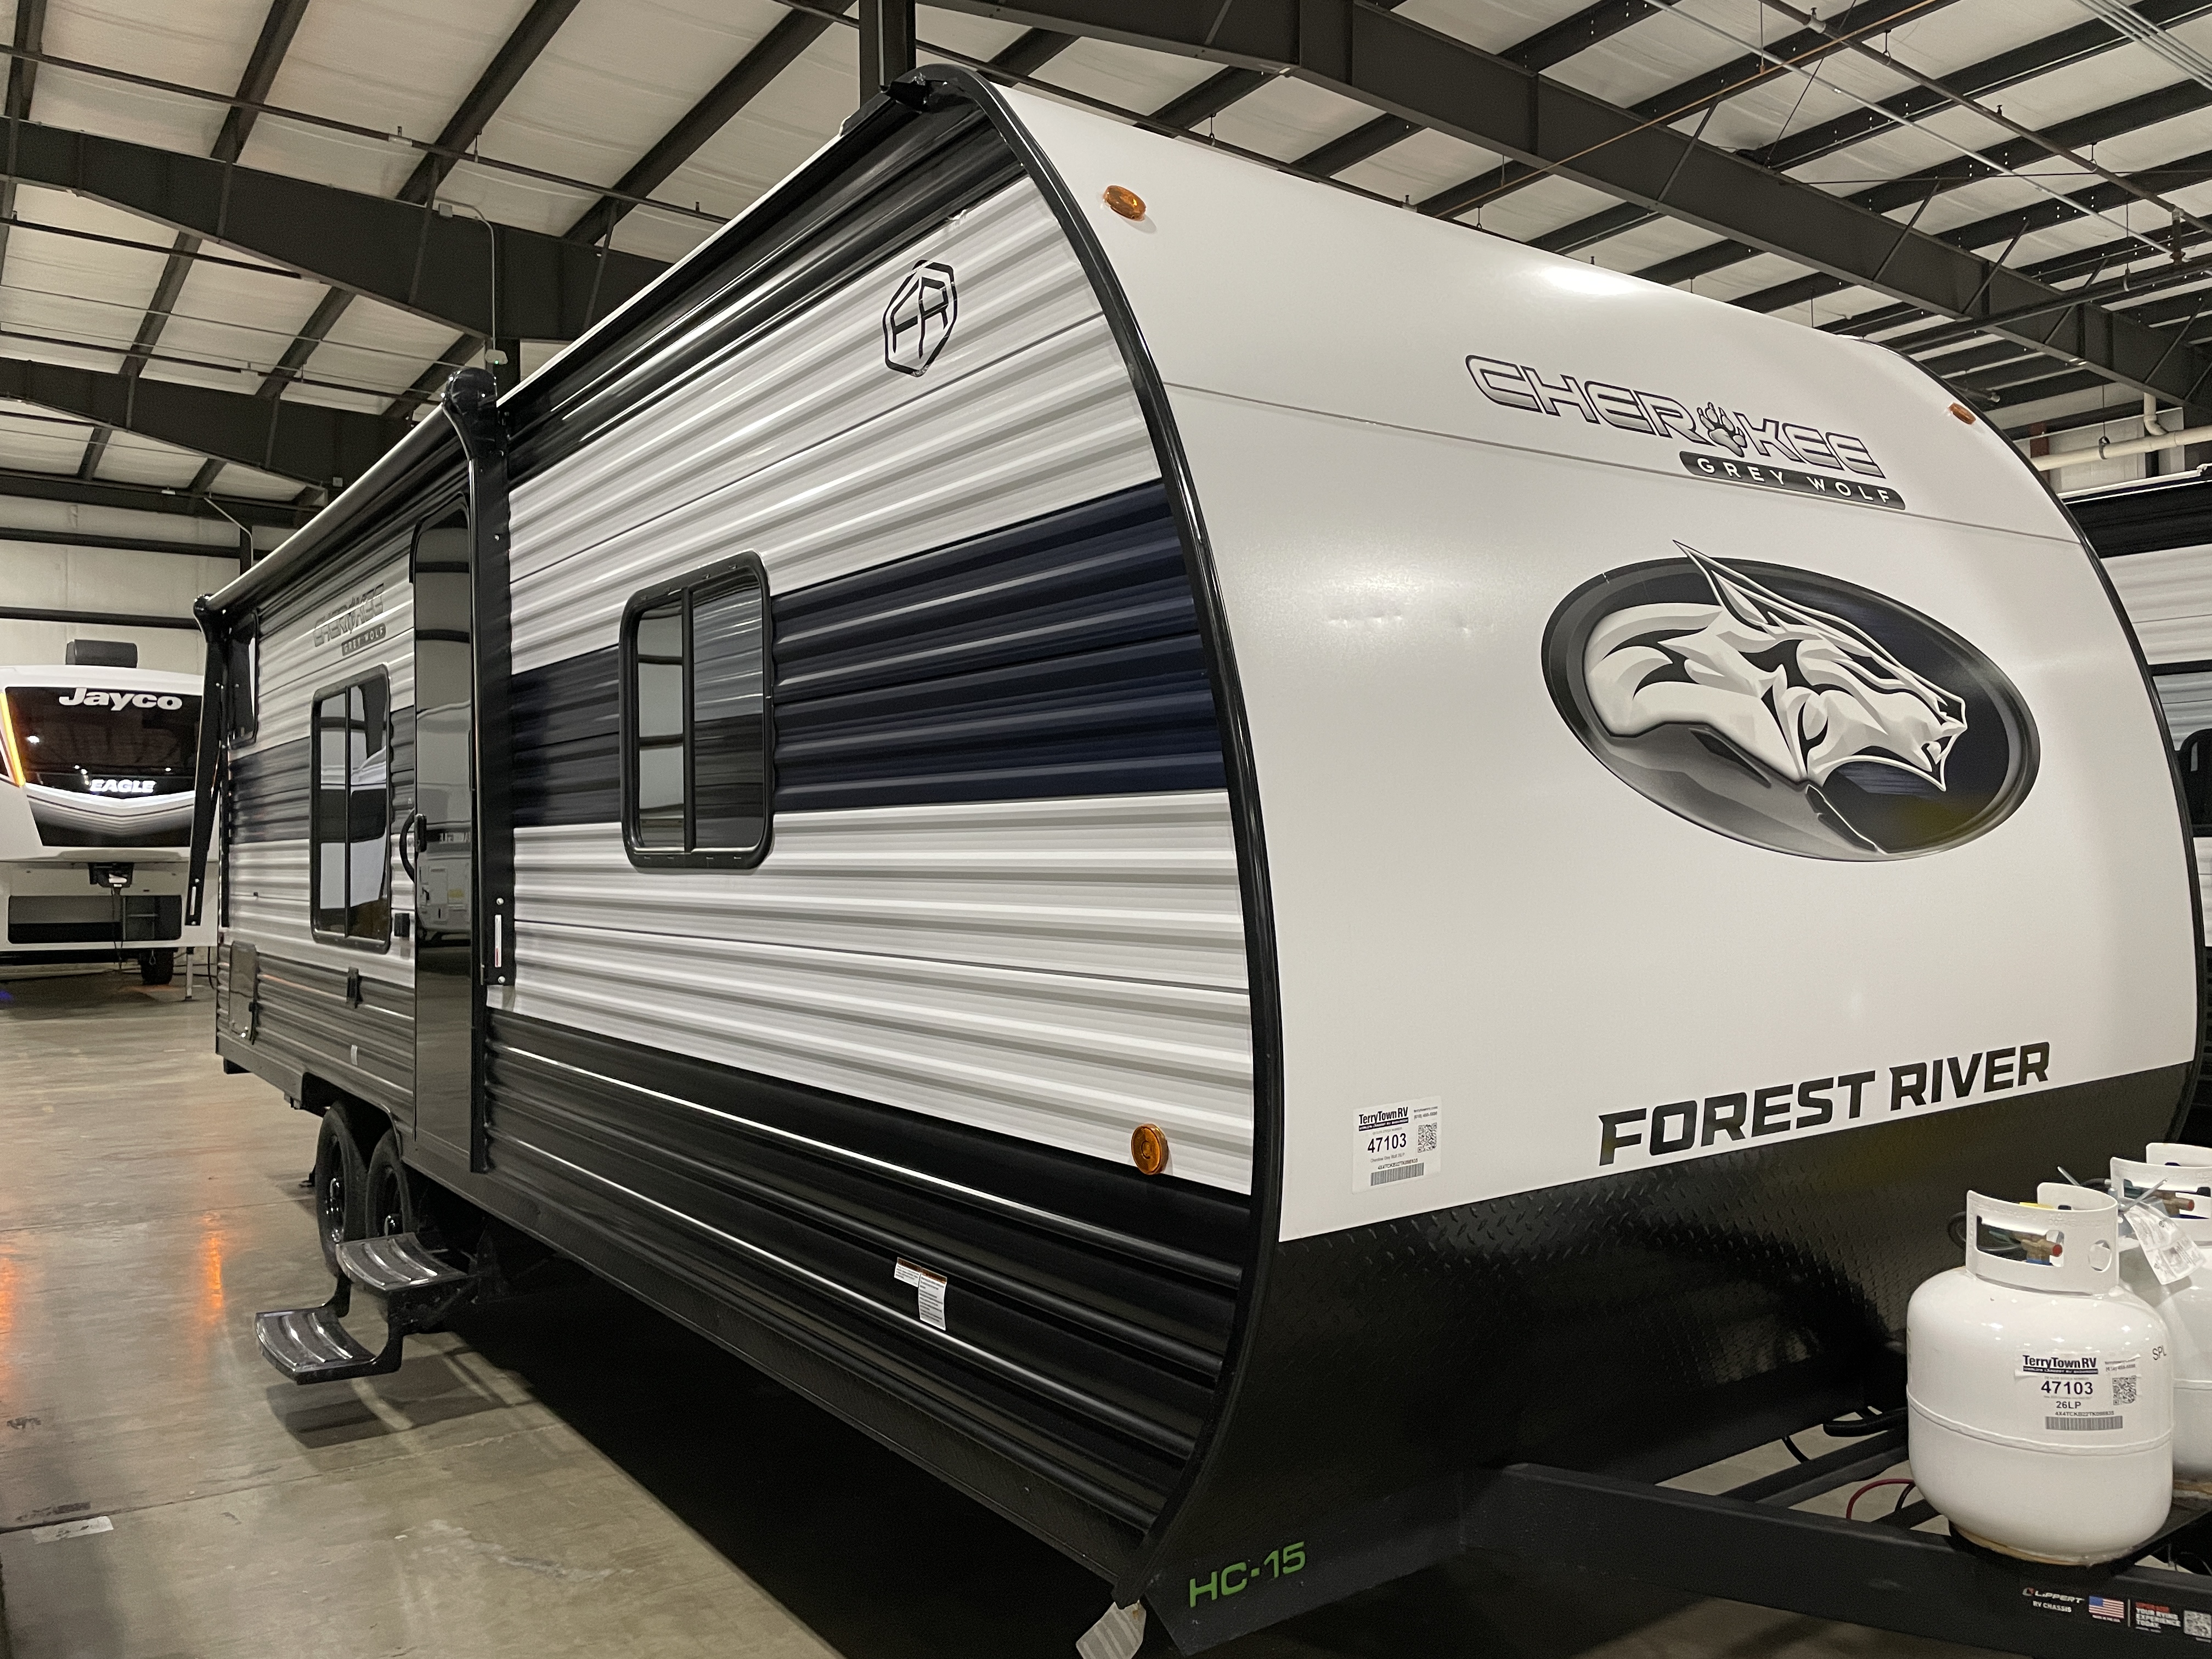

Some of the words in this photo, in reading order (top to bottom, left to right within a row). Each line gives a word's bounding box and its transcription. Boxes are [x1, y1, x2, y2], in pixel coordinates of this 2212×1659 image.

[1697, 458, 1784, 485] GREY
[1807, 476, 1889, 503] WOLF
[59, 687, 183, 711] Jayco
[89, 779, 156, 793] EAGLE
[1598, 1070, 1876, 1166] FOREST
[1889, 1041, 2050, 1111] RIVER
[1359, 1110, 1397, 1125] TerryTown
[1397, 1106, 1408, 1118] RV
[1367, 1133, 1407, 1153] 47103
[2023, 1355, 2081, 1369] TerryTown
[2081, 1357, 2097, 1368] RV
[2041, 1380, 2094, 1395] 47103
[2056, 1401, 2081, 1409] 26LP
[2042, 1602, 2072, 1613] CHASSIS
